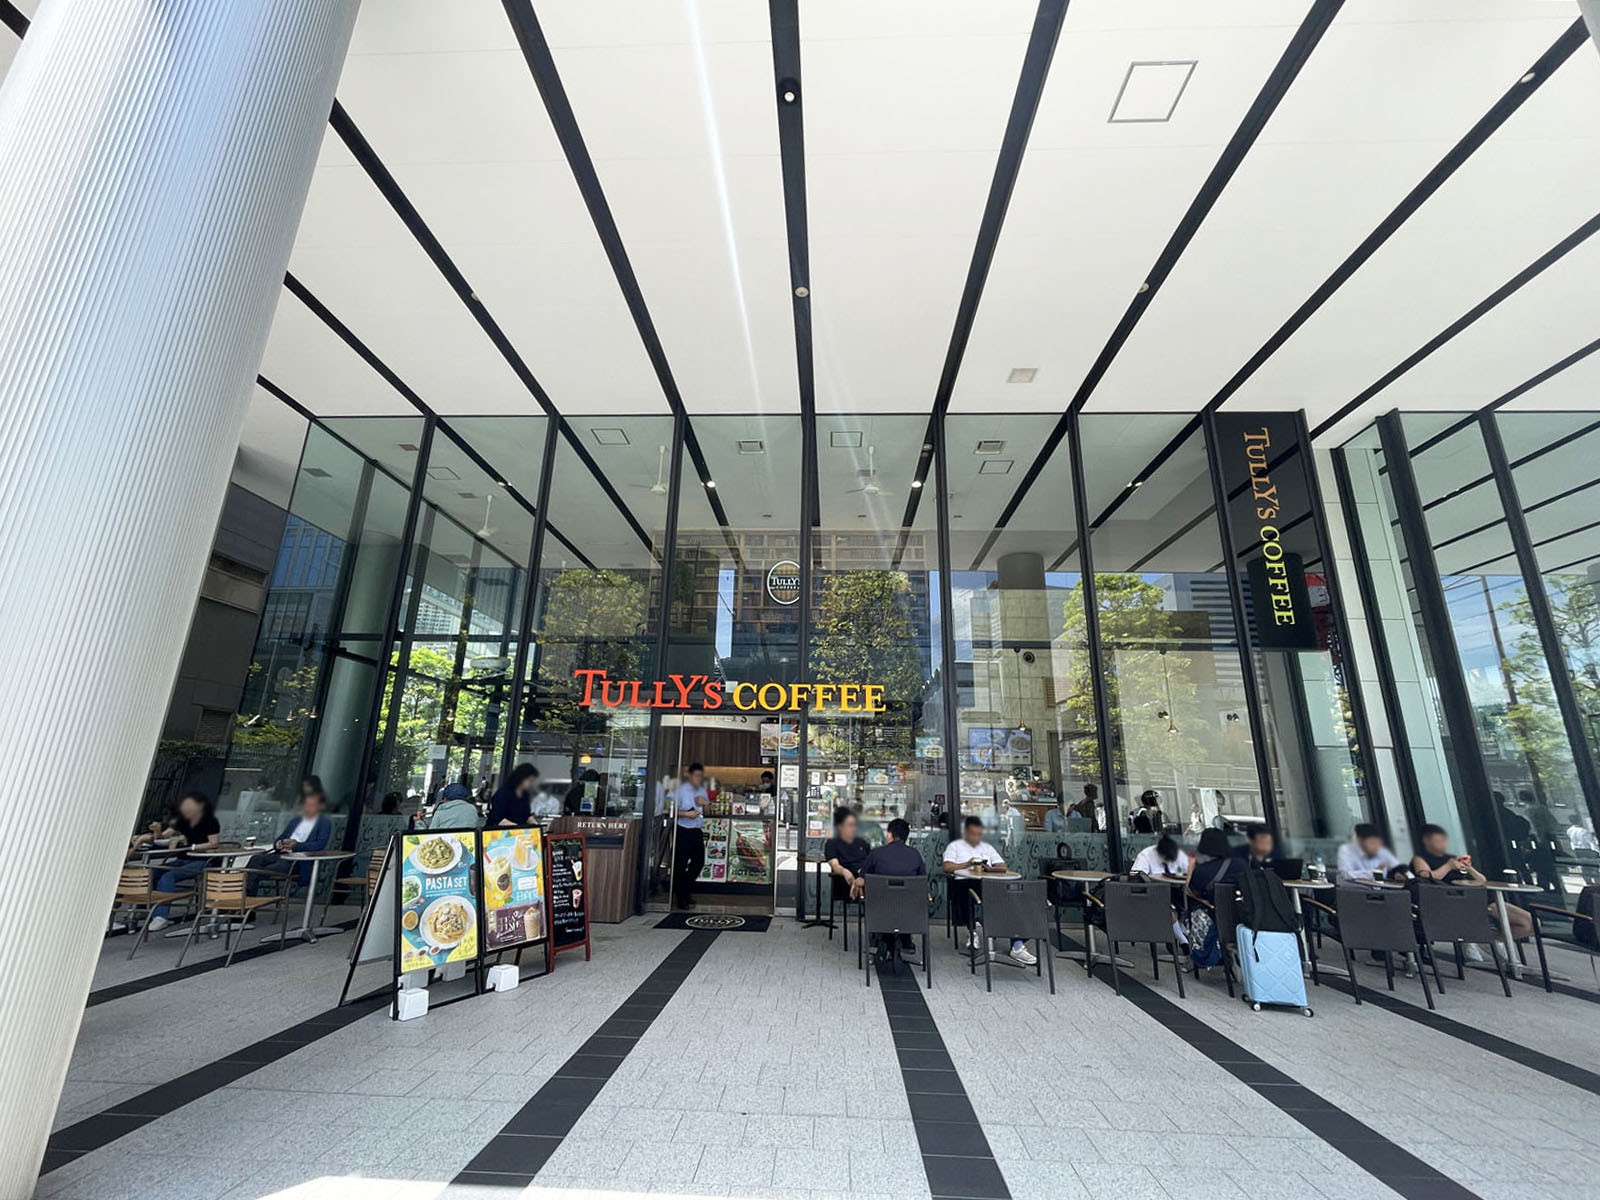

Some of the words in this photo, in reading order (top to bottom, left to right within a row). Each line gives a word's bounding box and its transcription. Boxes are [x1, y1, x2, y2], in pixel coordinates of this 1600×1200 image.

[1243, 427, 1281, 520] TULLY'S
[1260, 525, 1295, 627] COFFEE
[573, 668, 723, 709] TULLY'S
[732, 682, 887, 713] COFFEE
[577, 821, 607, 829] RETURN
[608, 822, 627, 830] HERE
[425, 876, 453, 890] PASTA
[454, 876, 467, 888] SET
